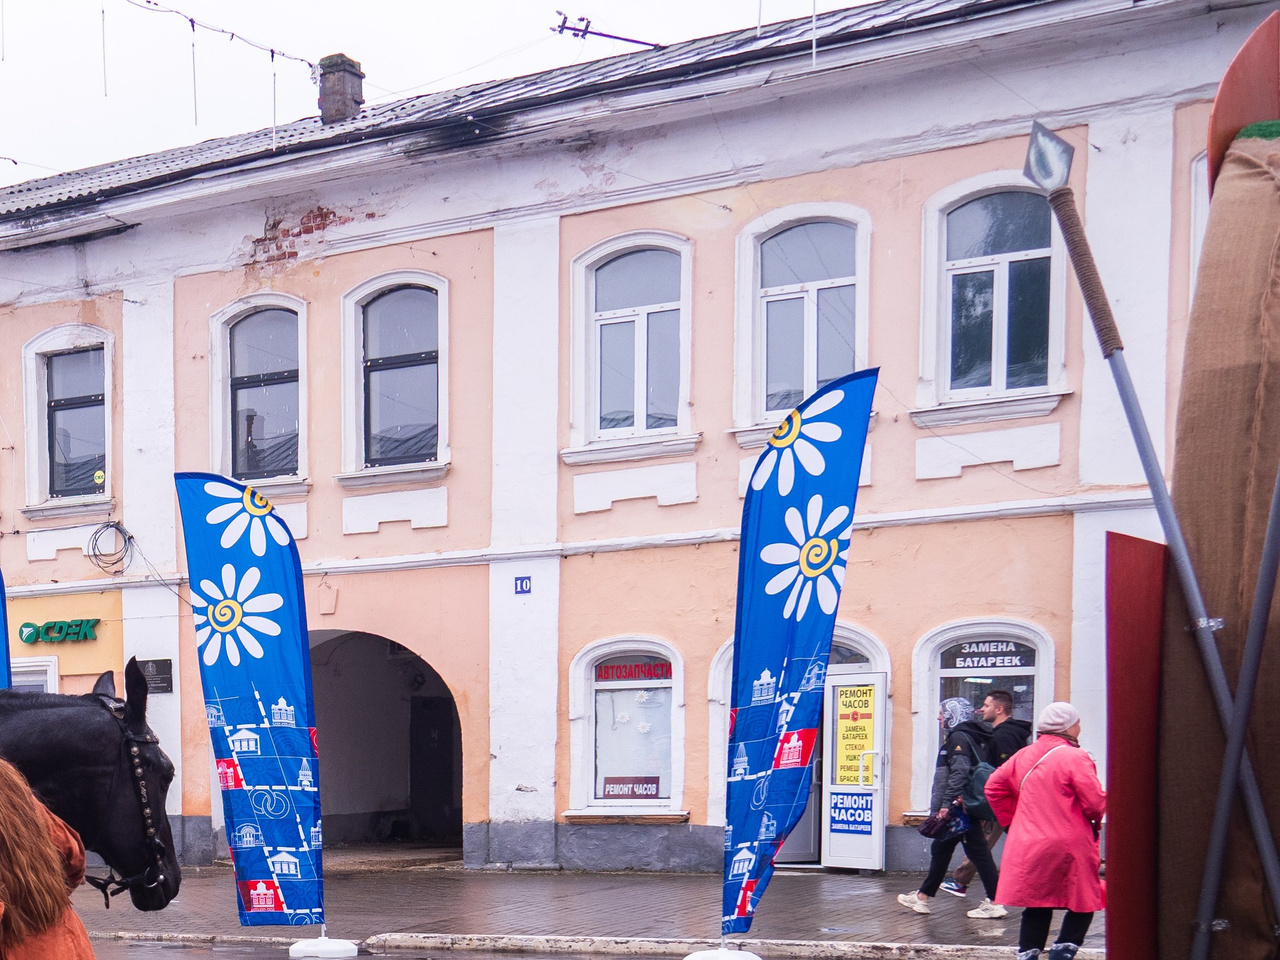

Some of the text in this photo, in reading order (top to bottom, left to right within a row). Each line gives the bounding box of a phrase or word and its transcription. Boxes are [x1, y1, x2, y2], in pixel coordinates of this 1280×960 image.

[516, 579, 530, 591] 10
[961, 642, 1016, 653] ЗАМЕНА
[955, 656, 1021, 667] БАТАРЕЕК
[597, 663, 672, 679] АВТОЗАПЧАСТИ
[840, 689, 873, 698] РЕМОНТ
[842, 700, 869, 708] ЧАСОВ
[605, 784, 657, 795] РЕМОНТ ЧАСОВ
[831, 794, 872, 808] РЕМОНТ
[831, 809, 872, 821] ЧАСОВ
